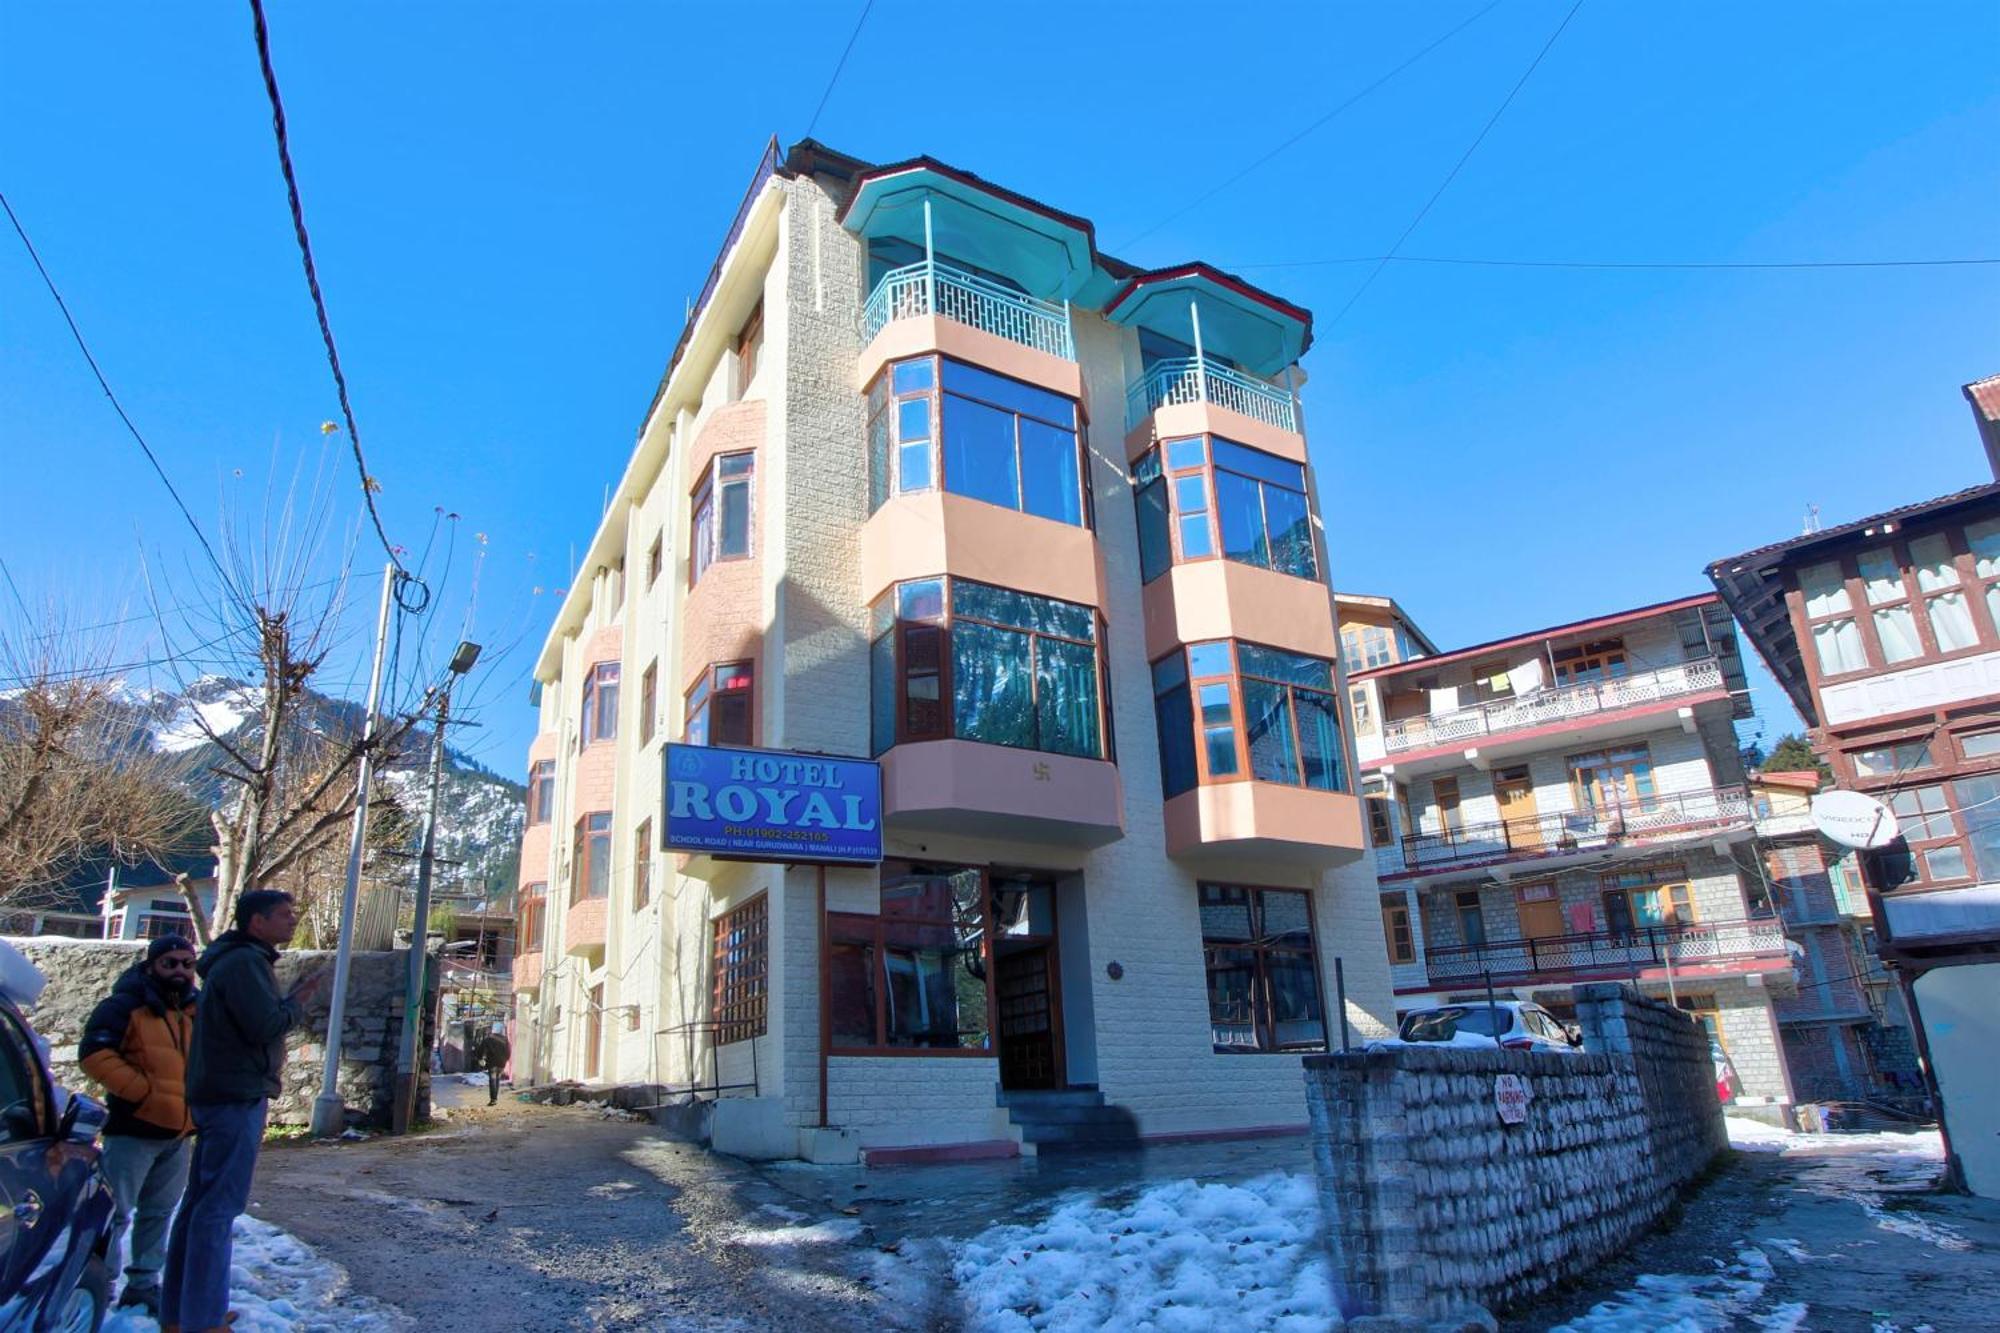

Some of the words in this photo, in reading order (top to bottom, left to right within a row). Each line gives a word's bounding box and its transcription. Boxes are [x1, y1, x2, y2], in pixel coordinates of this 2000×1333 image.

[731, 755, 844, 789] HOTEL
[669, 780, 875, 831] ROYAL
[670, 835, 703, 845] SCHOOL
[704, 837, 727, 846] ROAD
[732, 839, 754, 848] NEAR
[755, 840, 804, 851] GURUDWARA
[810, 843, 836, 853] MANALI
